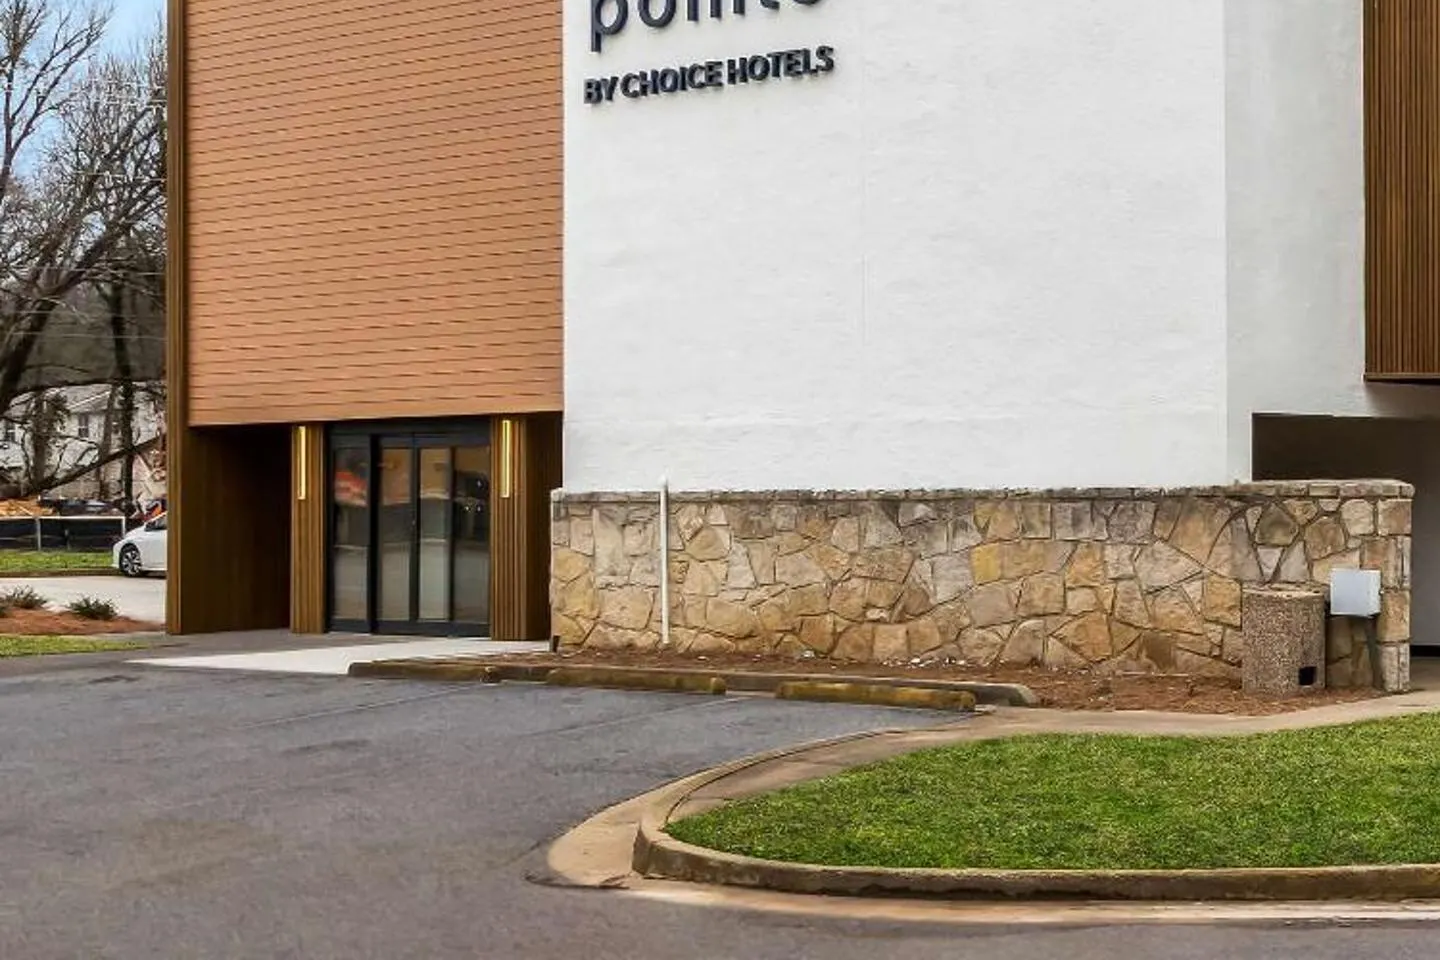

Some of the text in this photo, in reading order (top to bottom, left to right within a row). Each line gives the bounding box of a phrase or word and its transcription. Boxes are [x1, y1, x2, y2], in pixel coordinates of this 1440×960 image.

[584, 45, 835, 104] BY CHOICE HOTELS
